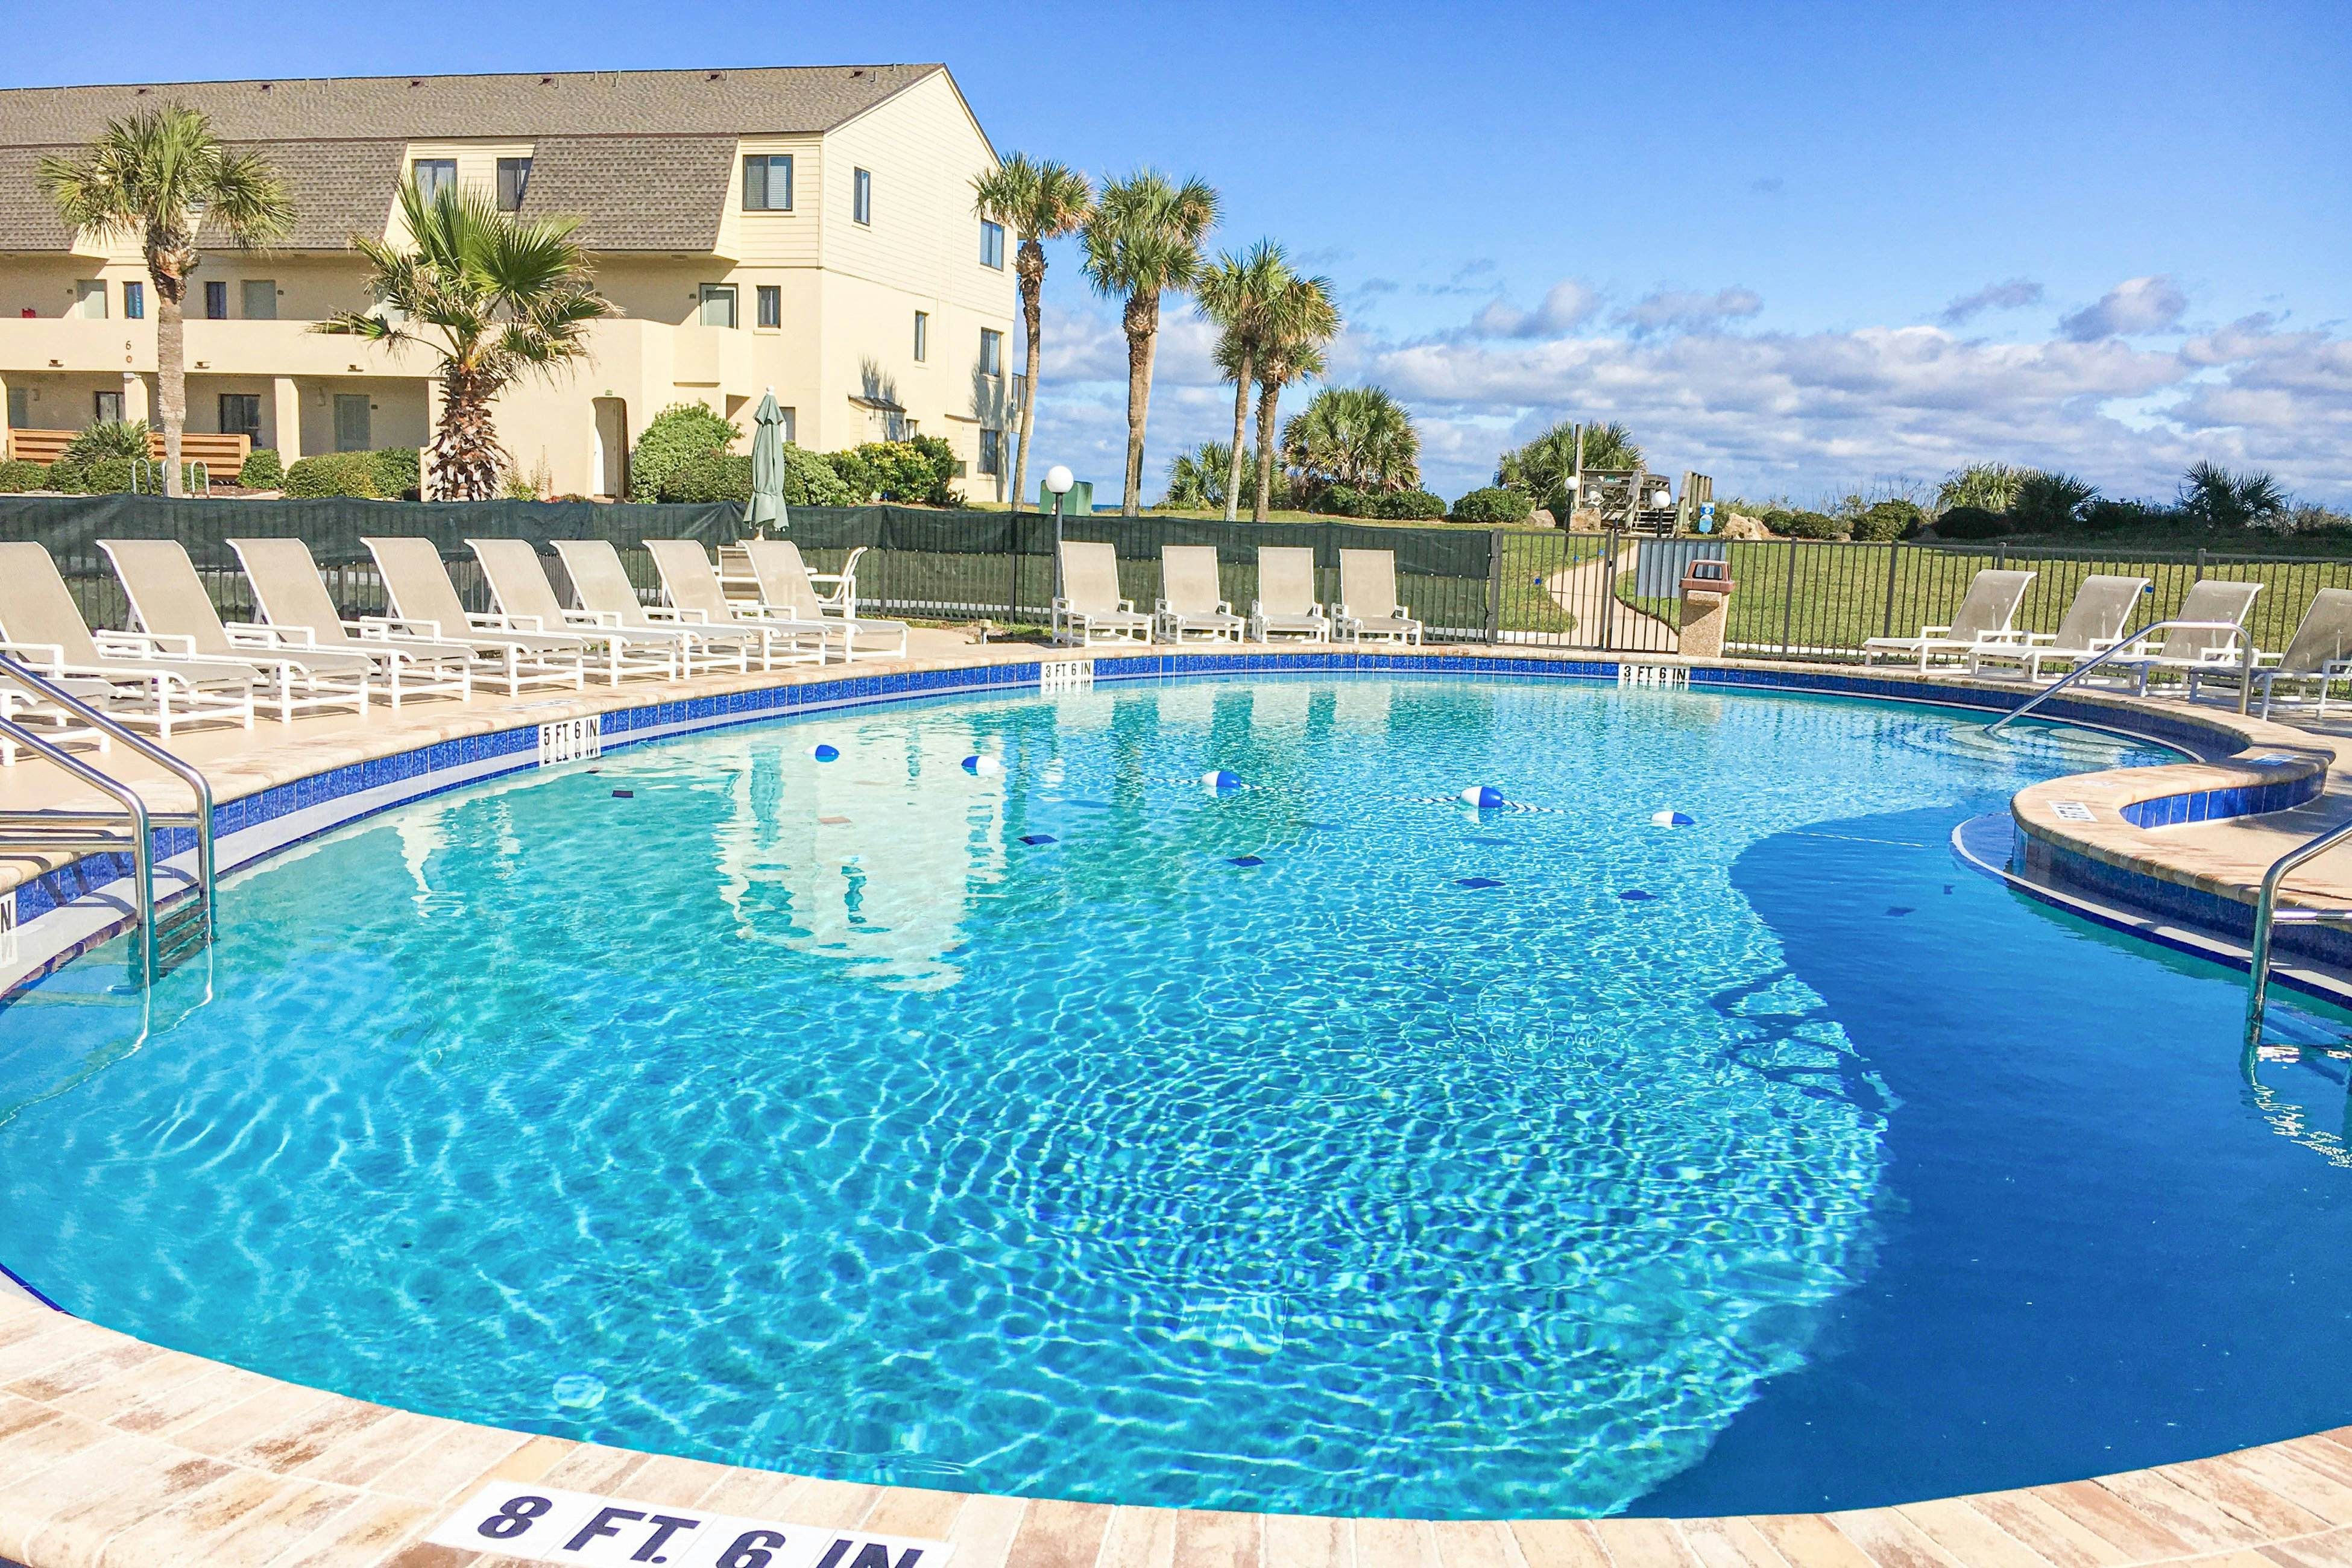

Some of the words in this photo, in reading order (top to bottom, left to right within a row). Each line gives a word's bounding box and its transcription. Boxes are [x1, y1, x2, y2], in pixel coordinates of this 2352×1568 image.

[125, 340, 131, 350] 6
[1045, 665, 1051, 678] 3
[1071, 663, 1076, 675] 6
[1624, 666, 1631, 677] 3
[1638, 666, 1653, 679] FT.
[1659, 667, 1666, 679] 6
[544, 727, 550, 746] 5
[575, 721, 581, 739] 6
[477, 1496, 553, 1539] 8
[562, 1507, 701, 1564] FT.
[715, 1529, 786, 1568] 6
